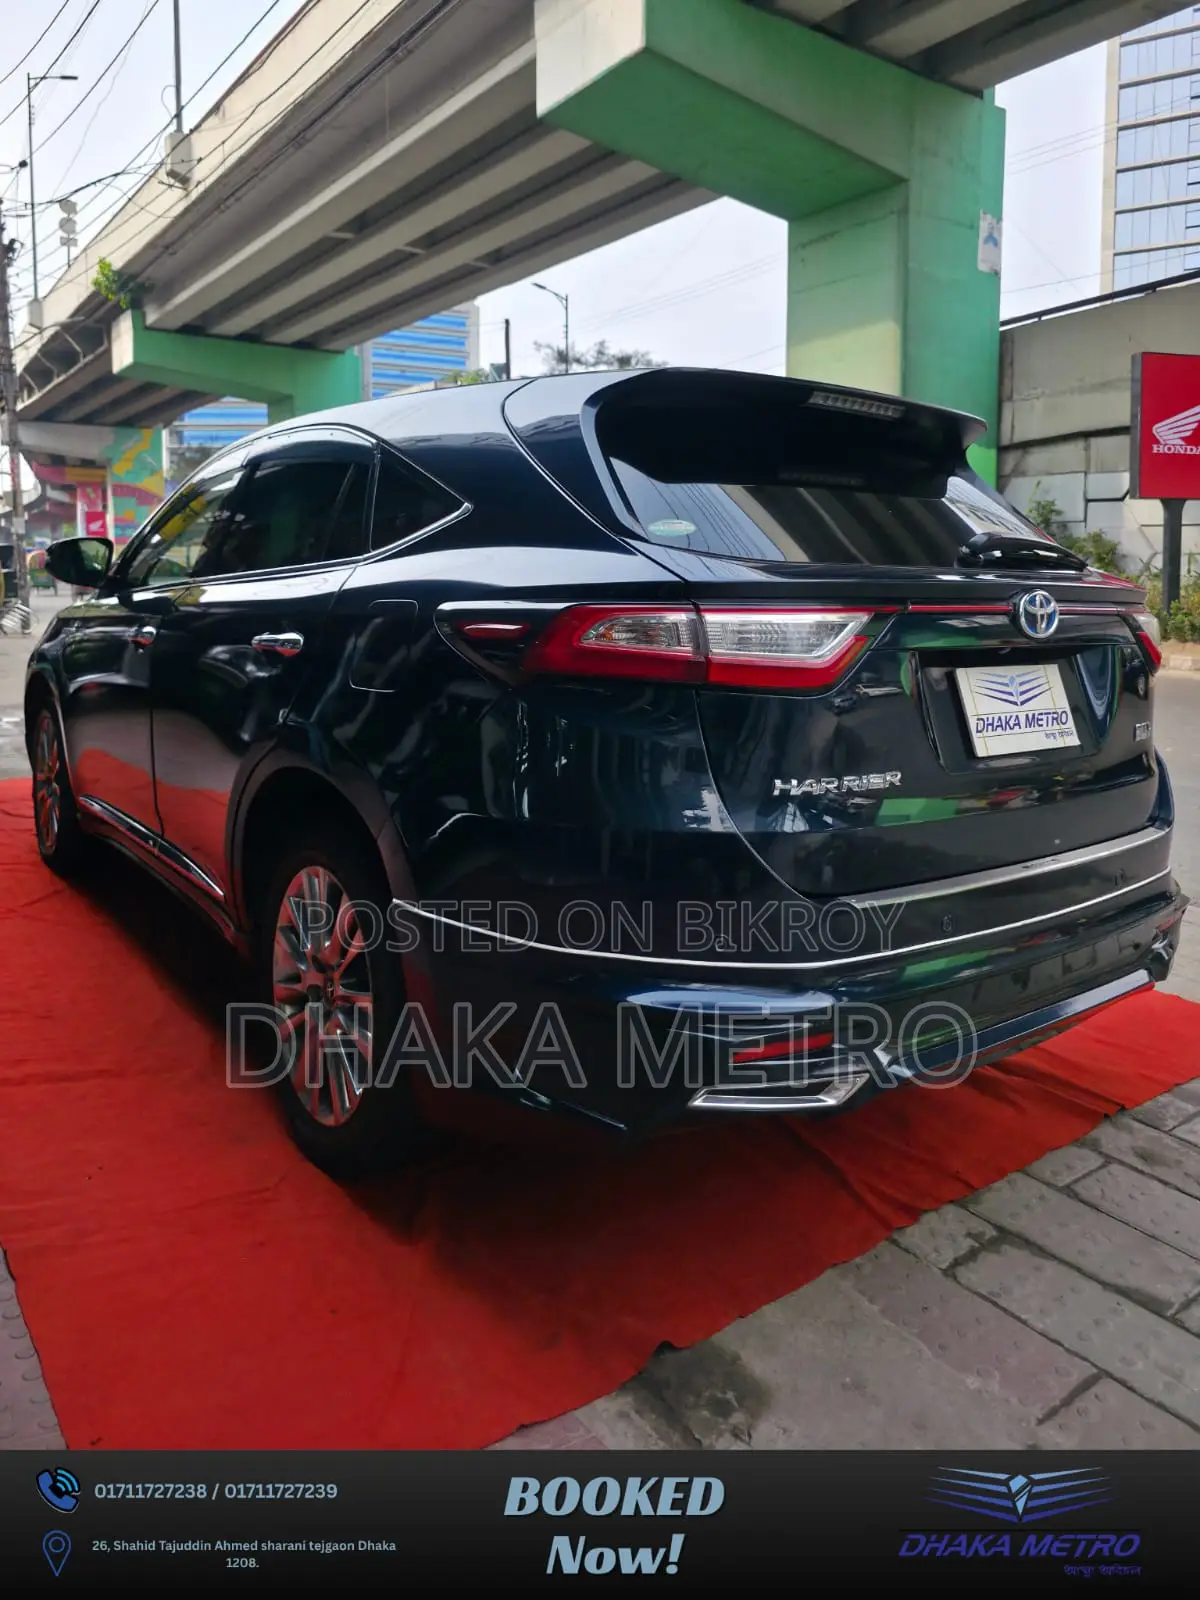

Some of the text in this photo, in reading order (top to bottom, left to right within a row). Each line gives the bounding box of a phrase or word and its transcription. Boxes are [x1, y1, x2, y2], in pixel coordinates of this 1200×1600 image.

[975, 710, 1069, 734] DHAKA METRO
[772, 771, 902, 796] HARRIER
